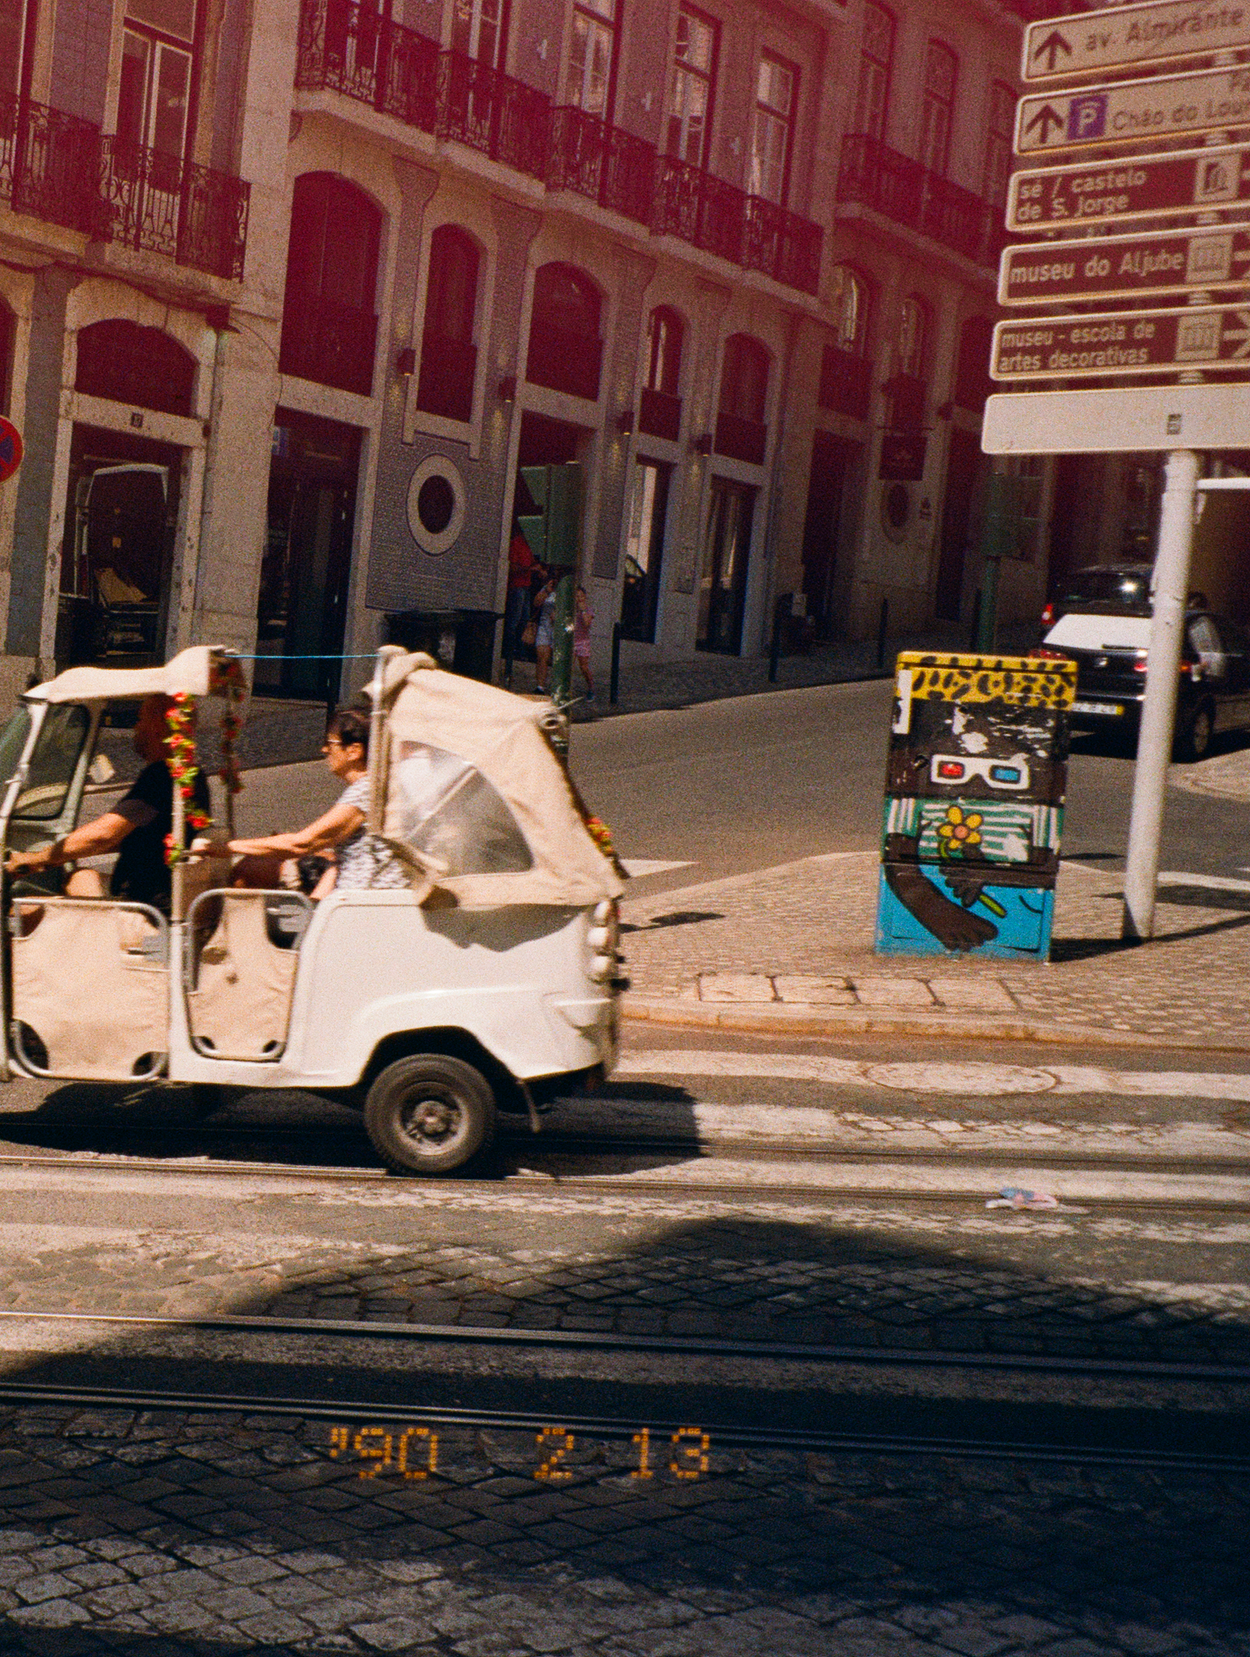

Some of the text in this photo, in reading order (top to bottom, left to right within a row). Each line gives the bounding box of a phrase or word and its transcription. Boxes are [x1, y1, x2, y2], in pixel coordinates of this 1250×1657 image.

[1113, 108, 1165, 131] Chão
[1172, 104, 1199, 123] do
[1019, 179, 1044, 199] sé
[1071, 168, 1148, 193] castelo
[1017, 202, 1043, 221] de
[1051, 198, 1069, 218] S.
[1010, 250, 1184, 283] museu do Aljube
[1002, 330, 1054, 348] museu
[1070, 321, 1127, 344] escola
[1133, 319, 1156, 339] de
[1000, 346, 1148, 372] artes decorativas
